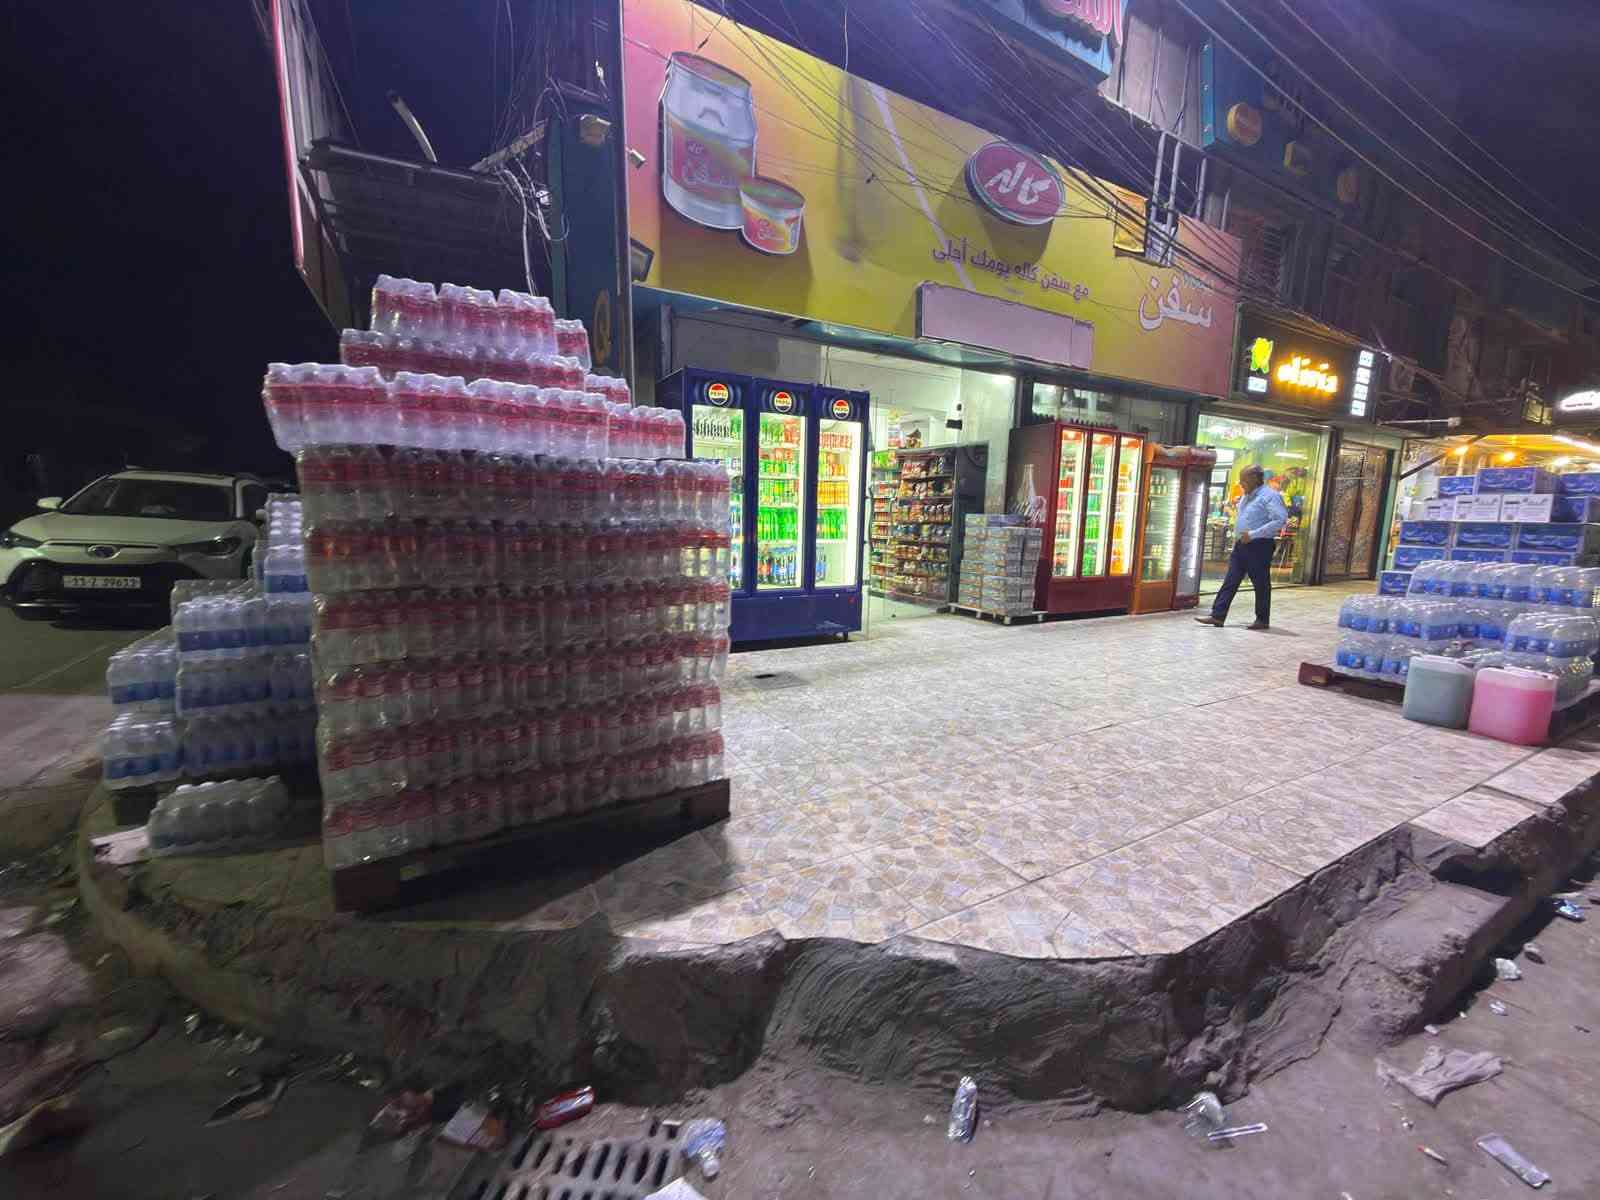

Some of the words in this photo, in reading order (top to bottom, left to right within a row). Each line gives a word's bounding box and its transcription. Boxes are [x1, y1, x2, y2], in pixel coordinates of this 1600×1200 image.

[983, 160, 1052, 205] كاله
[932, 237, 967, 264] أحلى
[970, 250, 1010, 279] يومك
[1014, 261, 1039, 281] كاله
[1041, 272, 1072, 290] سفن
[1072, 284, 1089, 301] مع
[1138, 275, 1213, 332] سفن
